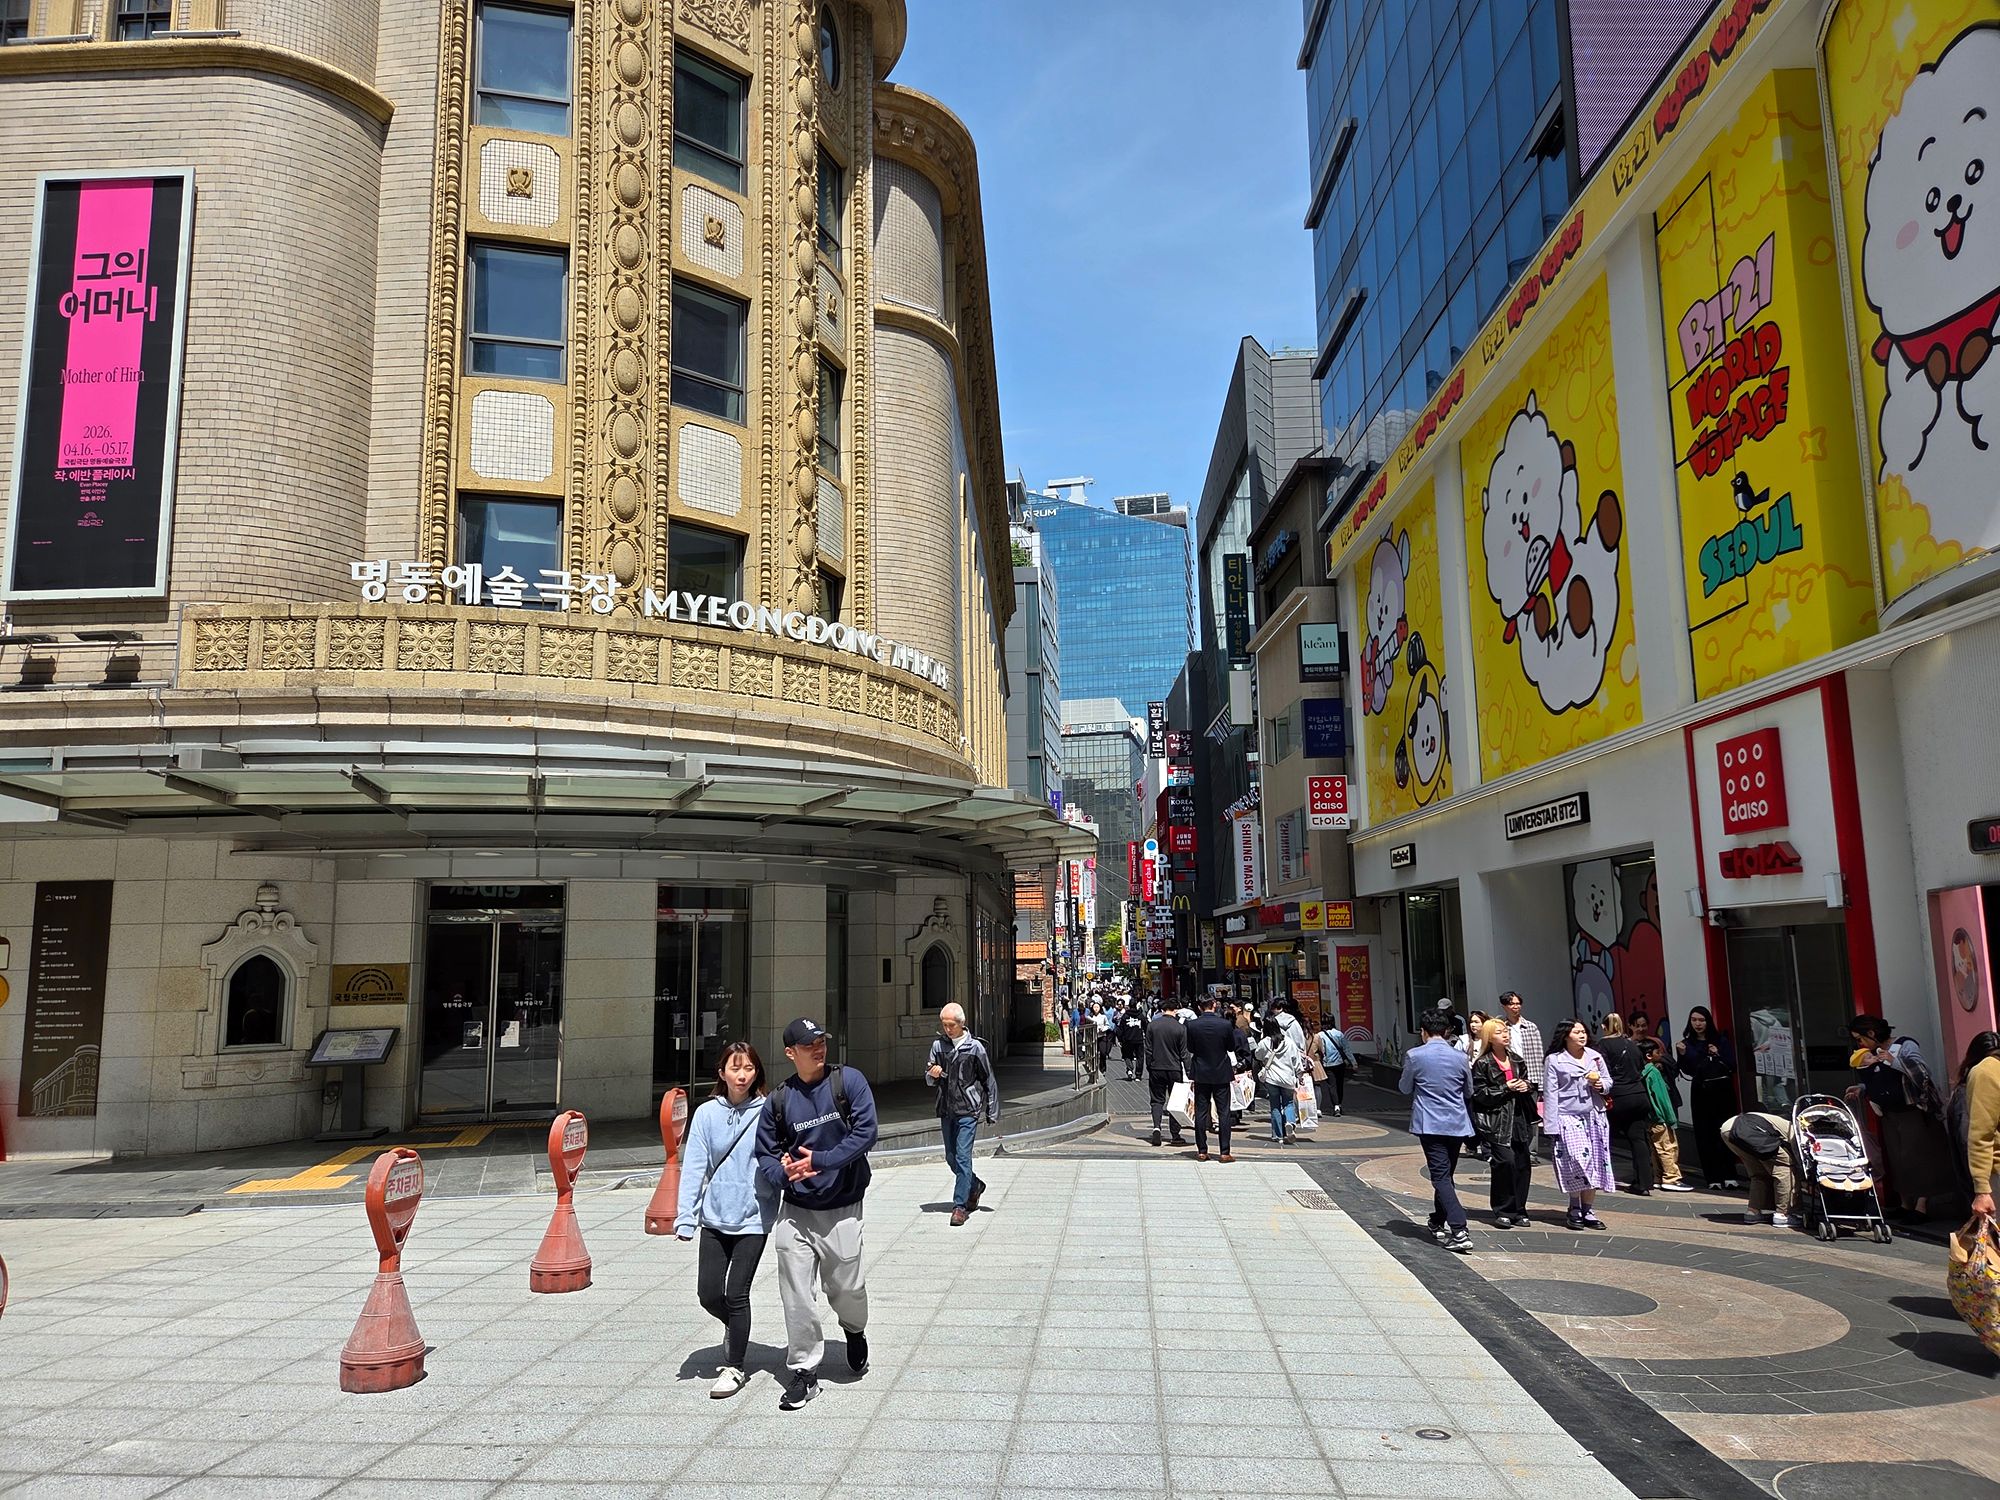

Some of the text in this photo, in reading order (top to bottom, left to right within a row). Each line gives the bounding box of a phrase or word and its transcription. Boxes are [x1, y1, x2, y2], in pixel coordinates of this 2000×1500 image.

[1612, 119, 1651, 197] BT21
[1653, 50, 1710, 145] WORLD
[77, 248, 145, 284] 그의
[59, 286, 158, 324] 어머니
[1678, 231, 1775, 375] BT21
[60, 366, 145, 385] Mother of Him
[1686, 320, 1782, 429] WORLD
[83, 425, 113, 439] 2026.
[1686, 366, 1790, 481] VOYAGE
[54, 468, 136, 482] 작. 에반 플레이시
[1699, 491, 1804, 600] SEOUL
[350, 559, 622, 614] 명동예술극장
[1228, 557, 1244, 608] 티안나
[643, 586, 886, 662] MYEONGDONG
[1150, 708, 1164, 751] 함흥냉면
[1311, 816, 1347, 826] 다이소
[1313, 801, 1344, 810] daiso
[1508, 799, 1579, 834] UNIVERSTAR BT21
[1728, 799, 1769, 822] daiso
[1242, 823, 1253, 862] SHINING
[1718, 841, 1804, 879] 다이소
[1243, 864, 1254, 892] MASK
[387, 1173, 419, 1197] 주차금지
